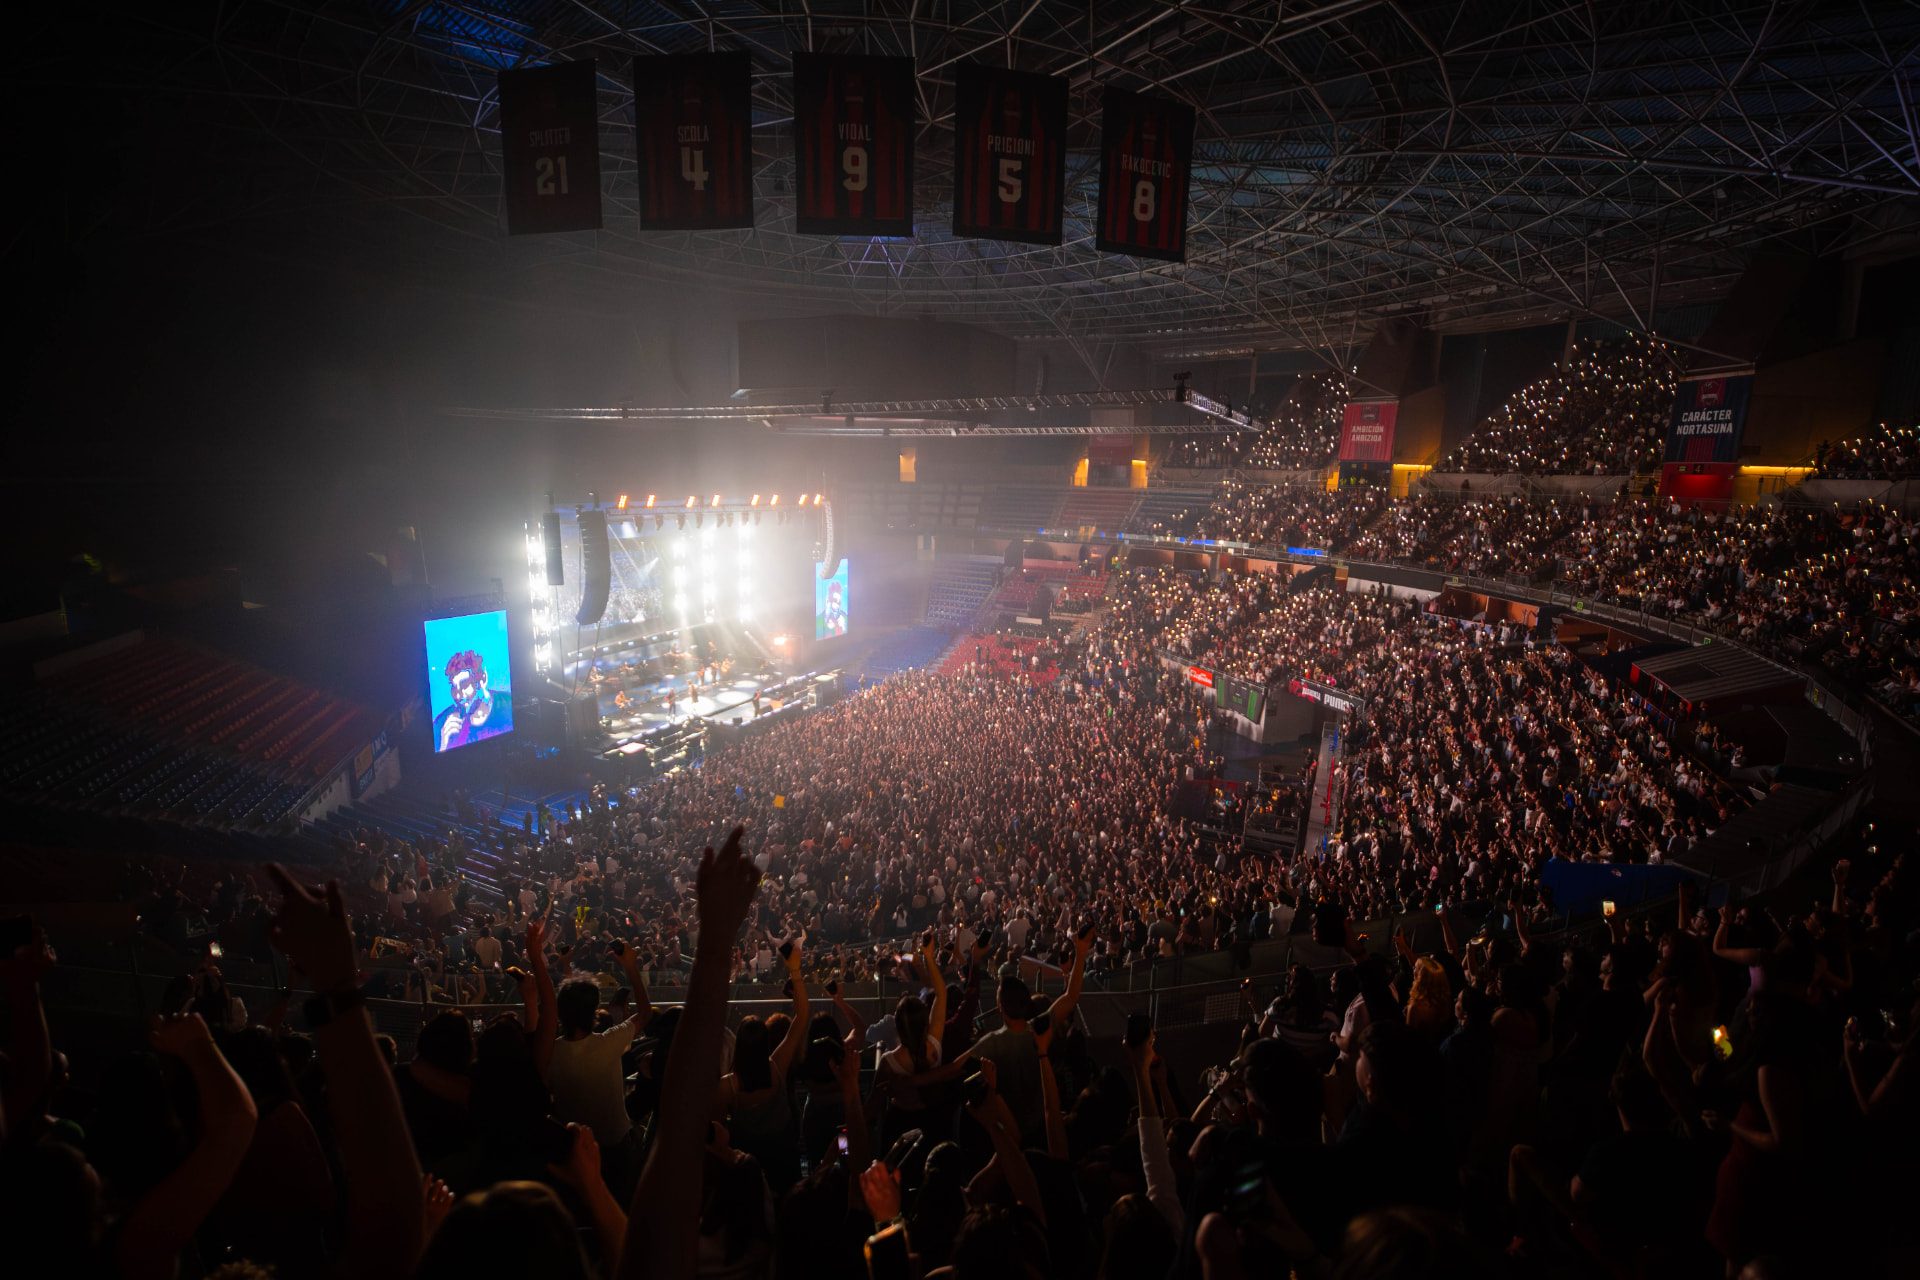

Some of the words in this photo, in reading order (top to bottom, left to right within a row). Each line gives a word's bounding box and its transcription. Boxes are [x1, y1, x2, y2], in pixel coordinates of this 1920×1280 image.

[838, 122, 872, 141] VIDAL
[987, 134, 1036, 157] PRIGIONI
[535, 155, 569, 195] 21
[681, 146, 709, 191] 4
[842, 146, 869, 191] 9
[998, 158, 1023, 203] 5
[1133, 180, 1156, 222] 8
[1676, 422, 1733, 435] NORTASUNA
[1682, 408, 1732, 422] CARÁCTER
